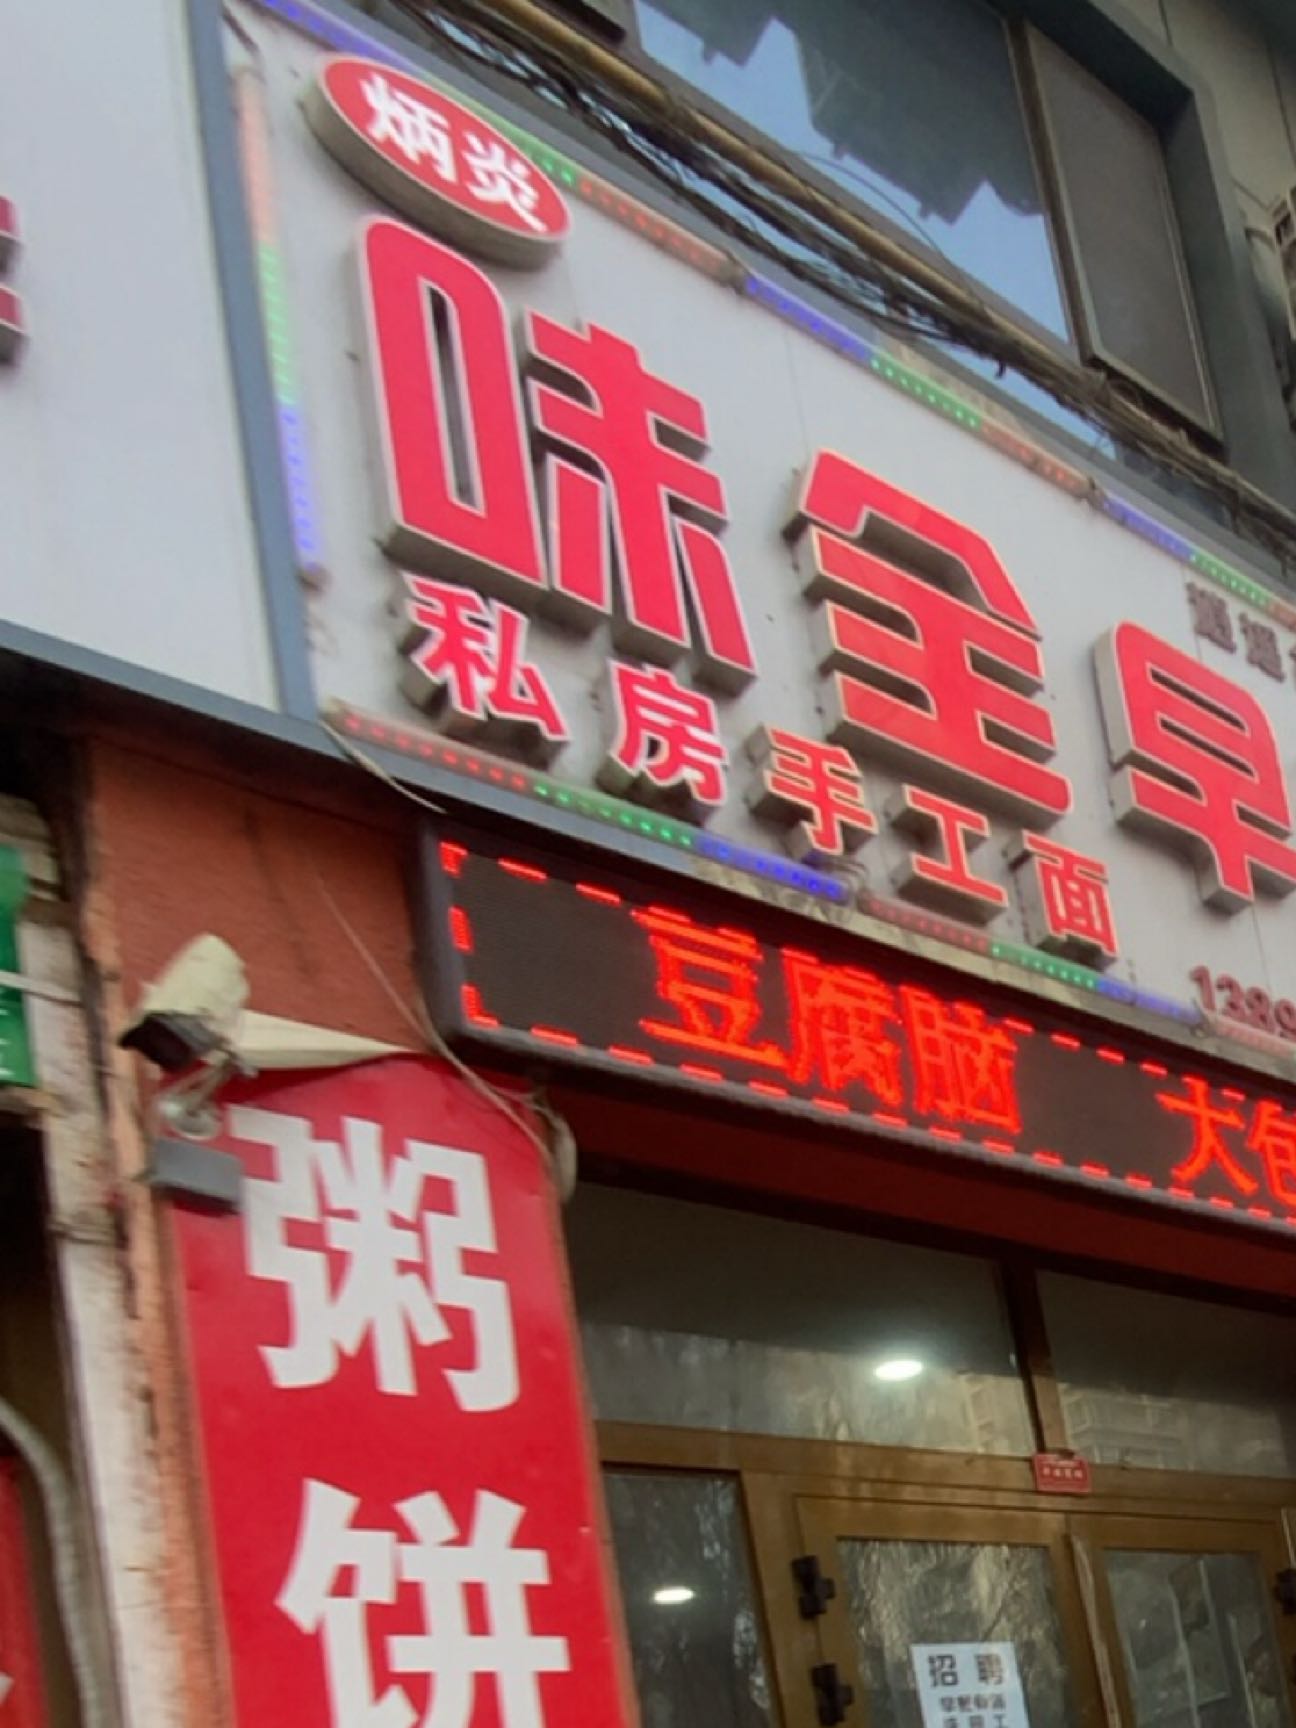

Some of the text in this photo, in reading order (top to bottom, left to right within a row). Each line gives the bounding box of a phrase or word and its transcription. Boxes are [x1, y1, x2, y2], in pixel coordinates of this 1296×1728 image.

[358, 70, 550, 233] 炳炎
[402, 575, 1120, 960] 私房手工面
[630, 904, 1021, 1136] 豆腐脑
[928, 1653, 1005, 1688] 招聘
